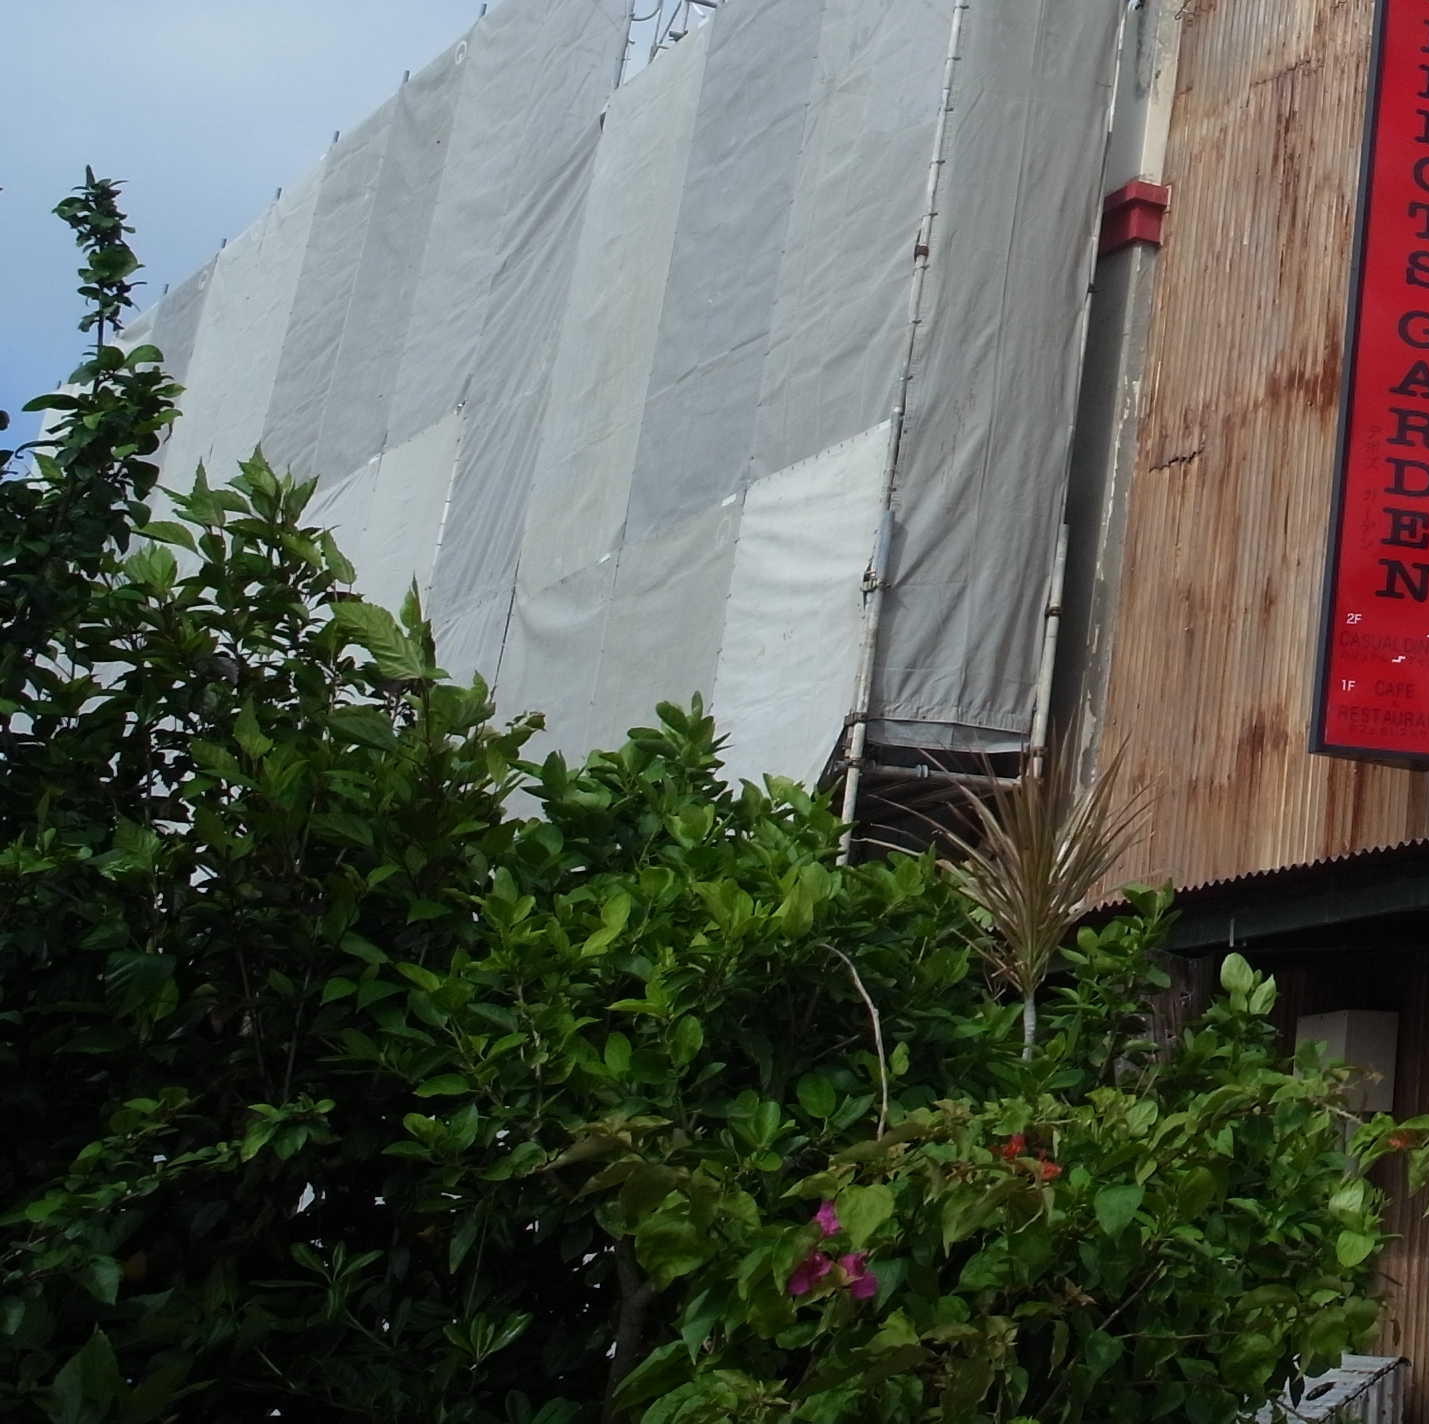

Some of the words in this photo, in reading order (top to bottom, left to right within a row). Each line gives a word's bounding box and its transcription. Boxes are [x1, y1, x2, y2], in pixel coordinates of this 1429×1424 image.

[1346, 612, 1363, 625] 2F
[1339, 631, 1402, 653] CASUAL
[1341, 679, 1356, 692] 1F
[1374, 680, 1415, 700] CAFE
